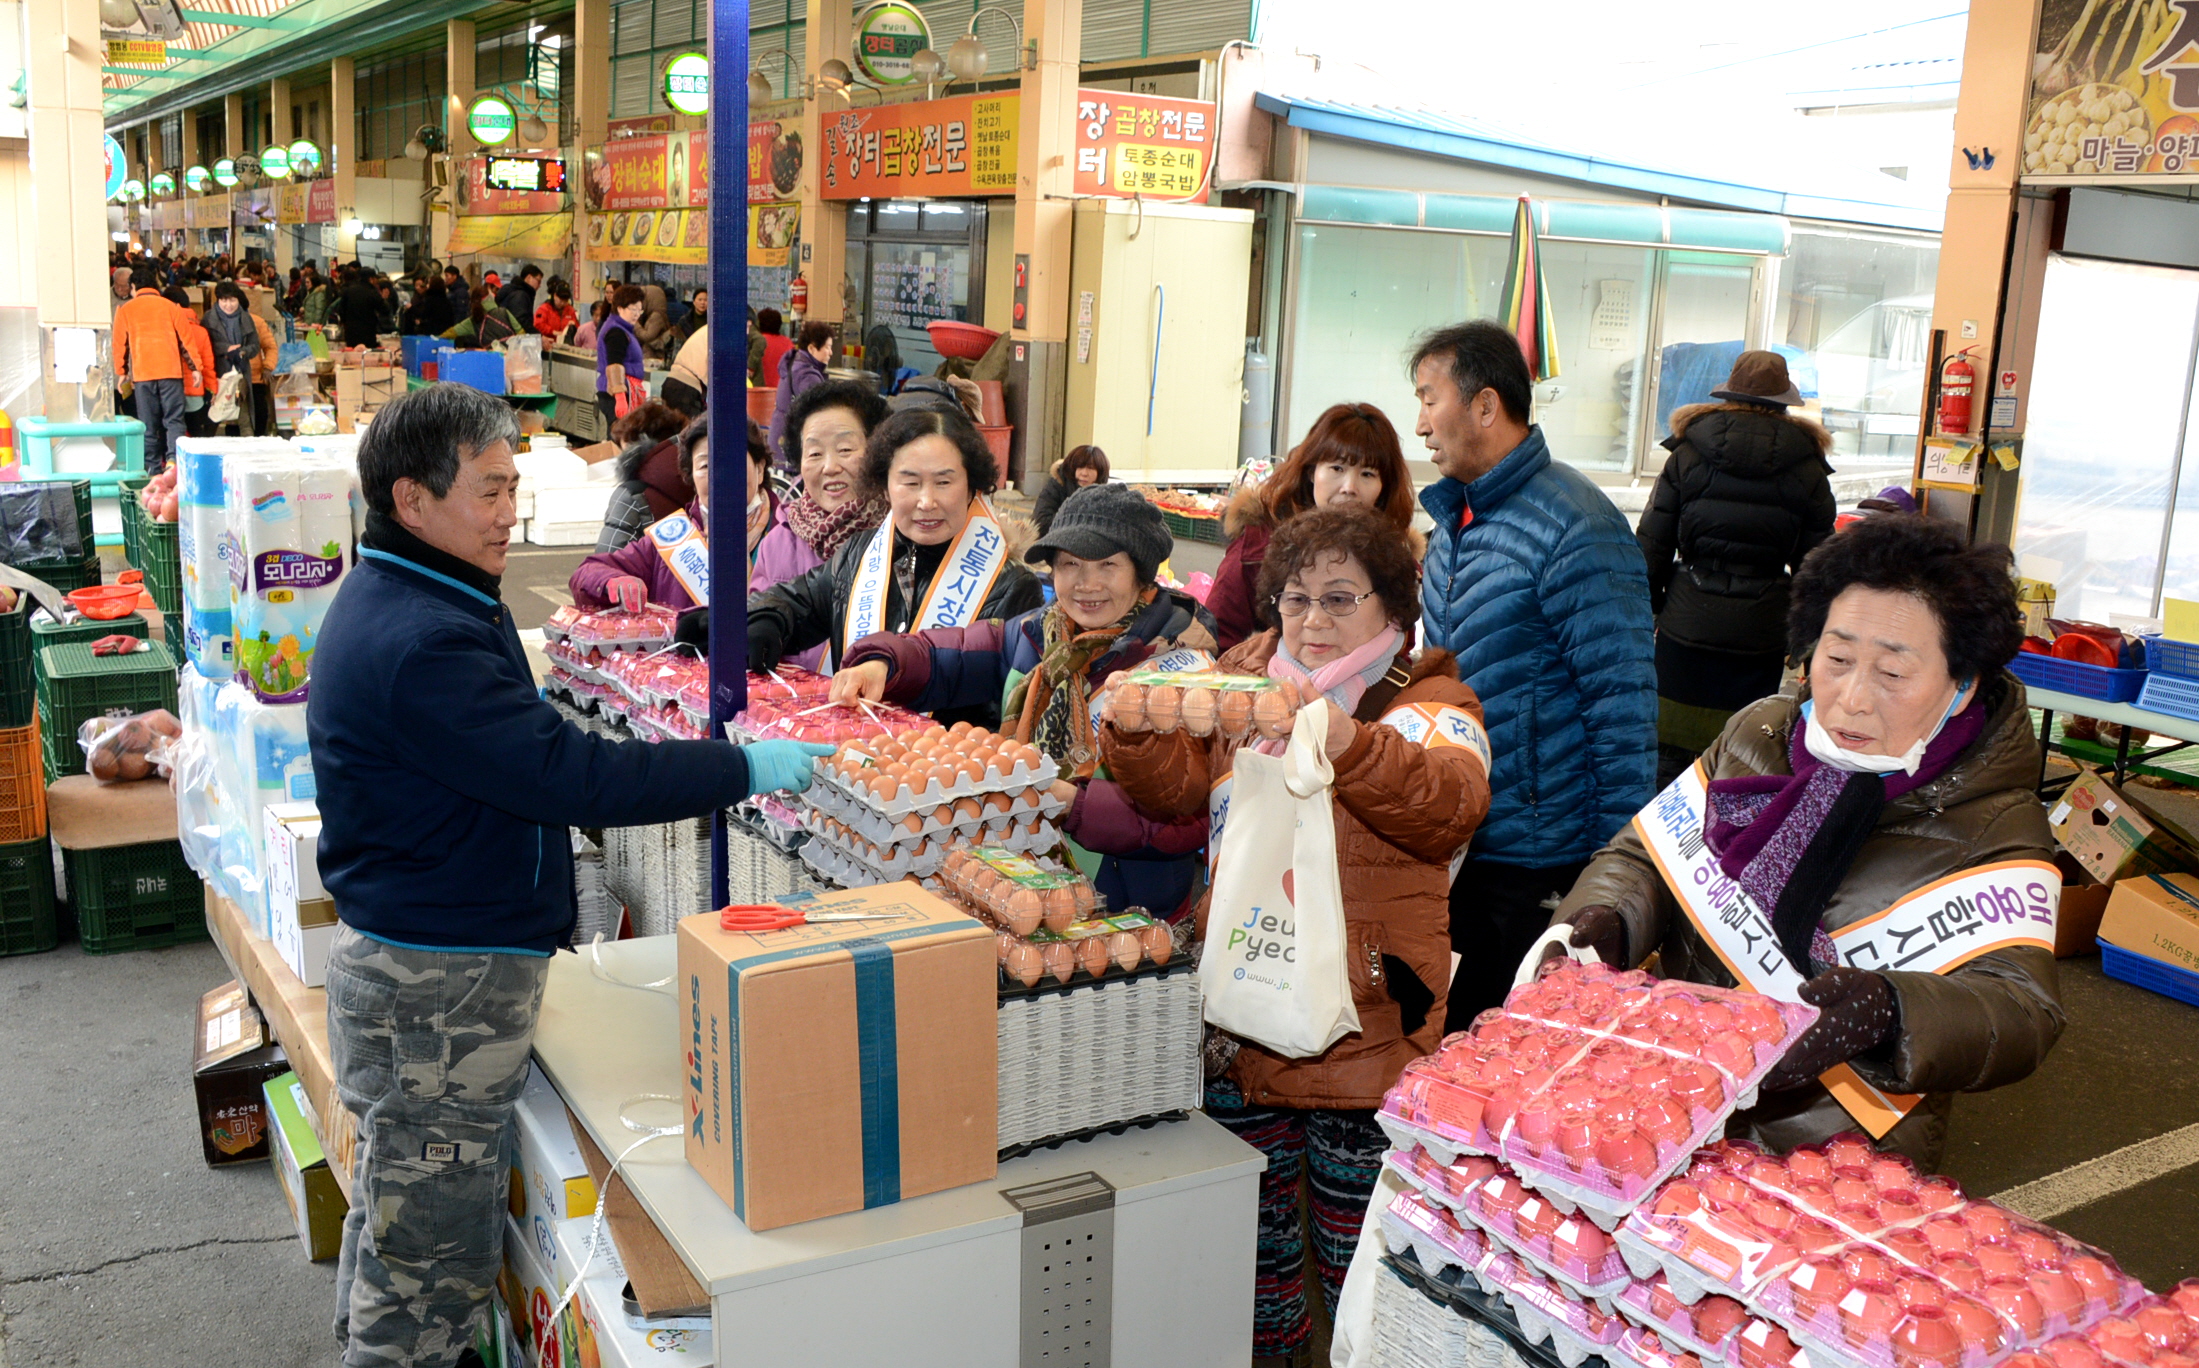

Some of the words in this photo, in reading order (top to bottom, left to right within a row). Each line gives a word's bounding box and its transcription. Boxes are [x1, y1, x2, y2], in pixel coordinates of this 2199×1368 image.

[669, 76, 709, 93] 장터순
[1115, 105, 1206, 143] 곱창전문
[845, 120, 967, 178] 장터곱창전문
[1123, 148, 1195, 169] 토종순대
[612, 153, 665, 193] 장터순대
[1122, 170, 1195, 192] 암뽕국밥
[264, 561, 327, 580] 모나리자
[679, 546, 710, 596] 증평시
[936, 525, 1000, 627] 전통시장
[1243, 907, 1296, 937] Jeu
[1247, 968, 1293, 991] www.jp.
[687, 974, 704, 1149] X-Lines
[711, 1060, 721, 1144] COVERING
